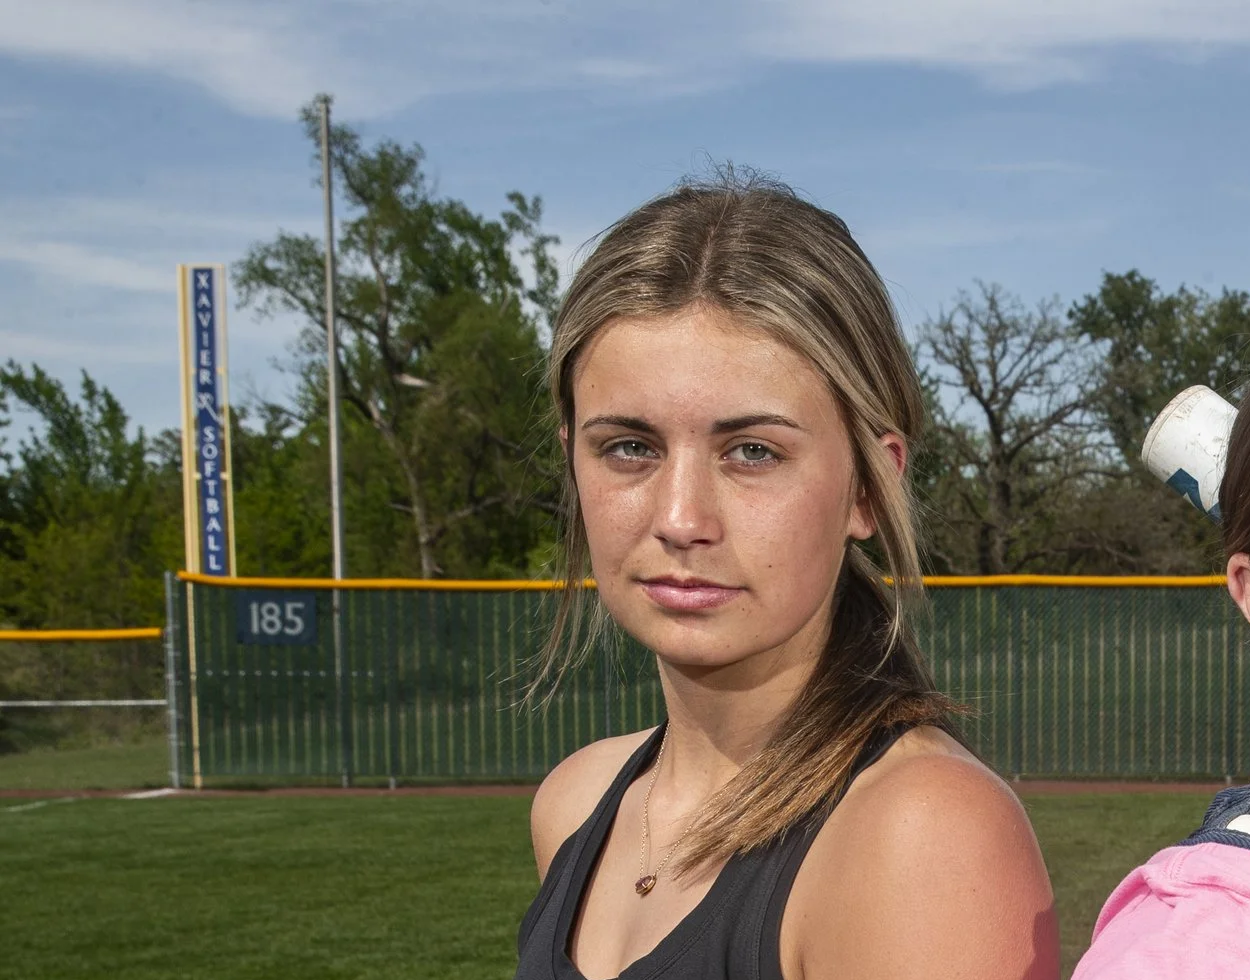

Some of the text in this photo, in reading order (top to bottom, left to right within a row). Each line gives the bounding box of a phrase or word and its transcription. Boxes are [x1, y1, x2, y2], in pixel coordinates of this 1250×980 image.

[197, 272, 213, 385] XAVIER
[202, 426, 222, 571] SOFTBALL
[249, 602, 304, 635] 185
